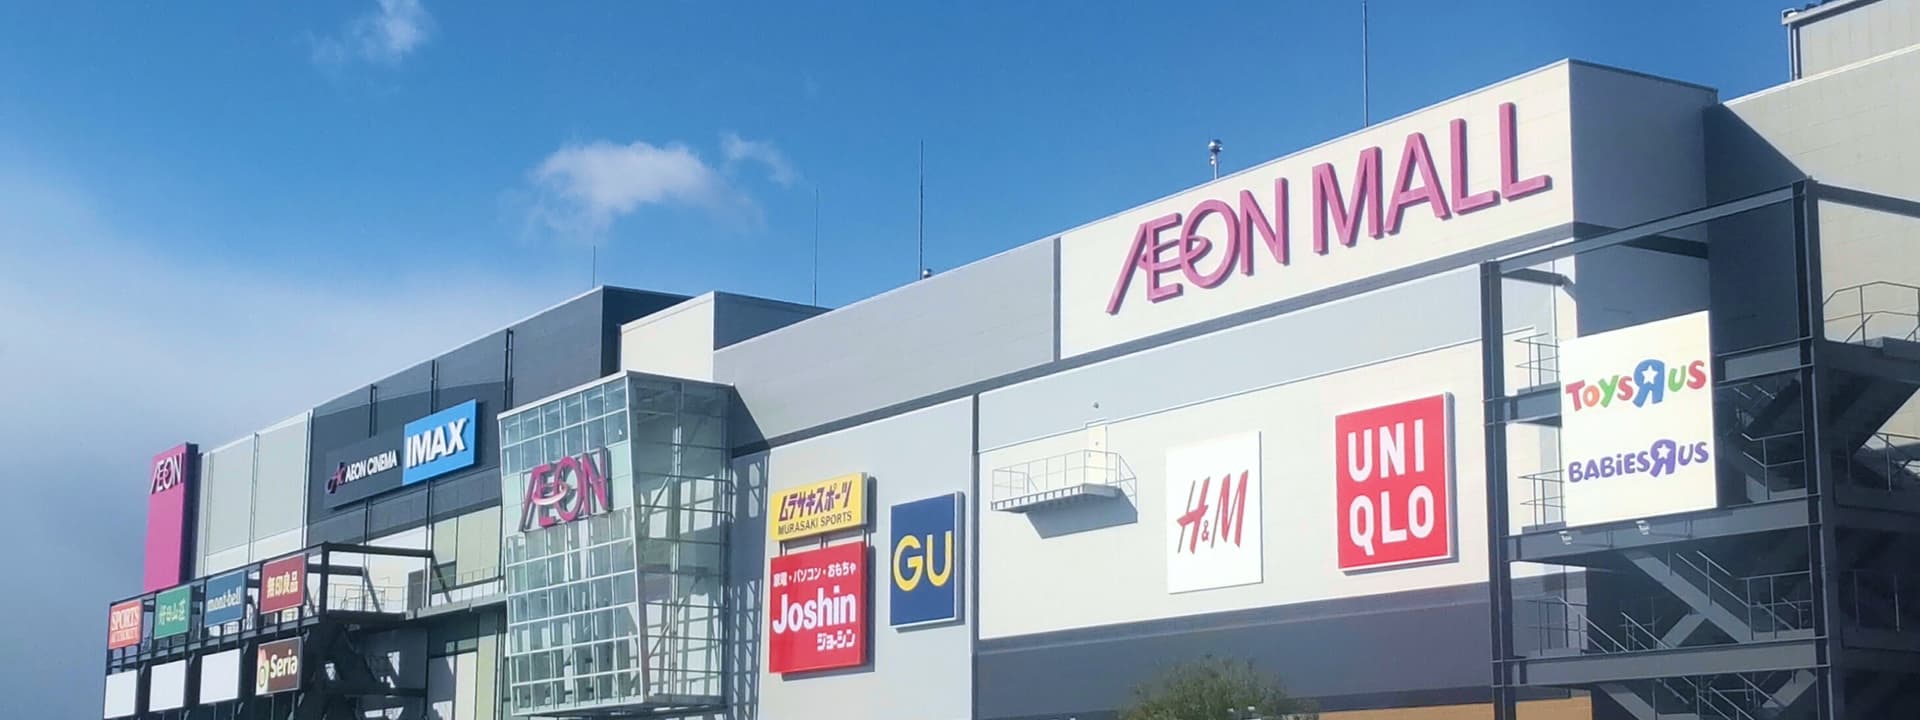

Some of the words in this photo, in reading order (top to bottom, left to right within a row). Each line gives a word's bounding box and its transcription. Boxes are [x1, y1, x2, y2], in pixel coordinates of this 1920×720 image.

[1312, 102, 1553, 255] MALL
[345, 459, 367, 482] AEON
[367, 449, 398, 475] CINEMA
[406, 416, 469, 469] IMAX
[1347, 418, 1425, 482] UNI
[777, 518, 819, 536] MURASAKI
[820, 510, 852, 527] SPORTS
[778, 479, 853, 522] ムラサキスポーツ
[1176, 469, 1249, 555] H&M
[1349, 485, 1435, 556] QLO
[266, 570, 299, 599] 無印良品
[893, 530, 952, 591] GU
[772, 585, 856, 635] Joshin
[270, 648, 298, 679] Seria
[816, 629, 856, 652] ジョーシン
